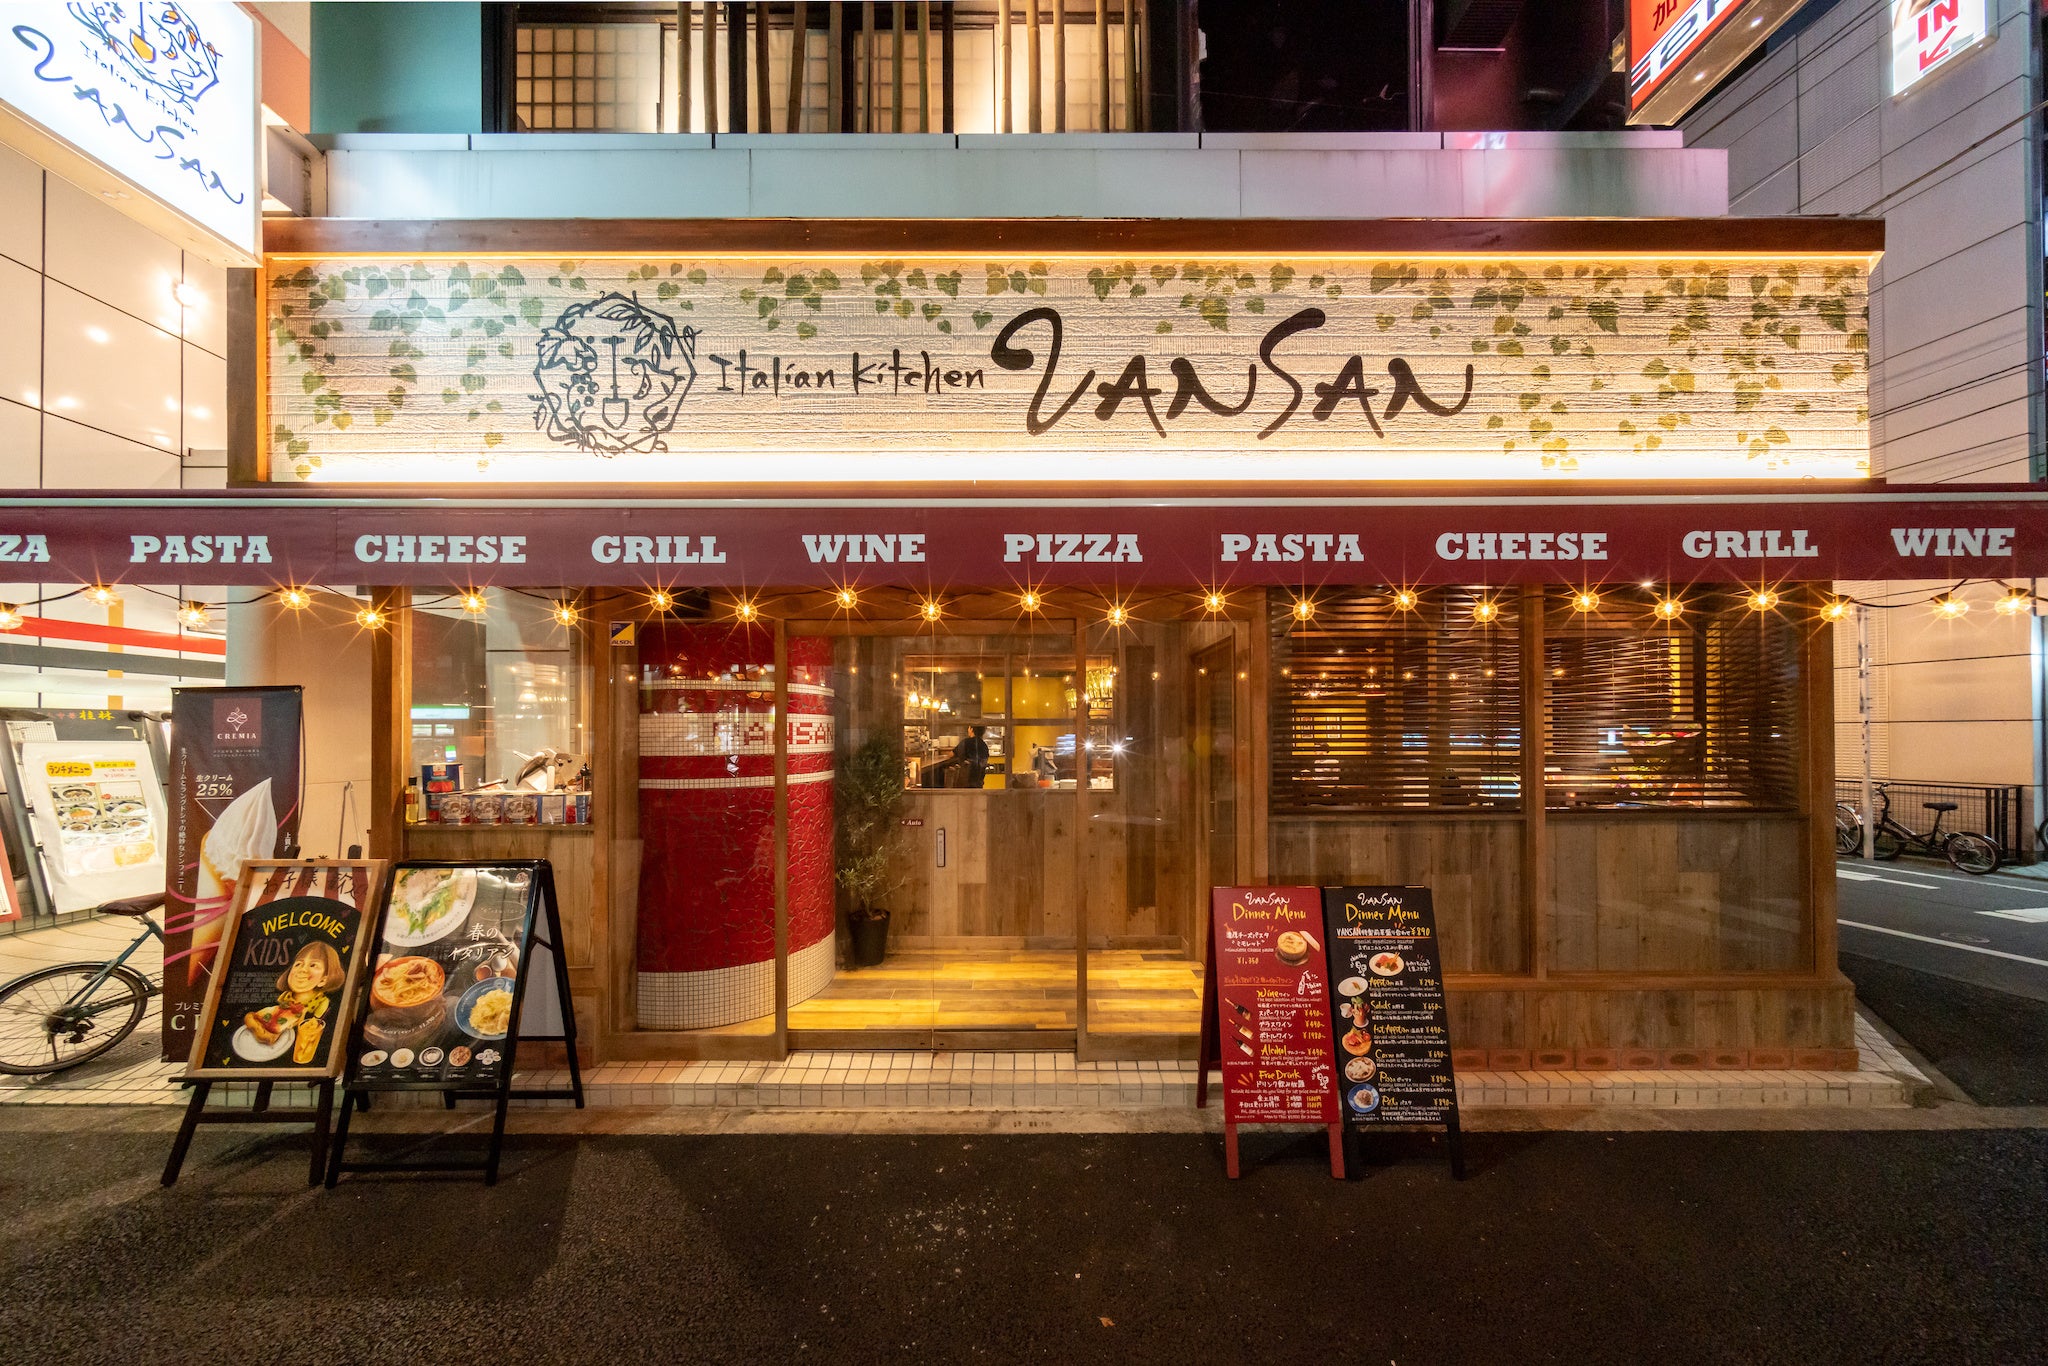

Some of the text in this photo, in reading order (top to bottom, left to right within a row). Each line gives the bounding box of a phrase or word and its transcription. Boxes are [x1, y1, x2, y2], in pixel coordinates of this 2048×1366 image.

[1918, 0, 1959, 44] IN
[708, 348, 835, 399] Italian
[129, 535, 273, 564] PASTA
[354, 534, 527, 564] CHEESE
[591, 535, 727, 564] GRILL
[801, 533, 926, 563] WINE
[1003, 533, 1143, 562] PIZZA
[1220, 534, 1365, 562] PASTA
[1435, 532, 1608, 561] CHEESE
[1682, 530, 1819, 559] GRILL
[1891, 528, 2015, 557] WINE
[48, 765, 91, 774] ランチメニュー
[195, 774, 234, 783] 生クリーム
[196, 783, 234, 797] 25%
[1232, 902, 1307, 923] Dinner Menu
[1345, 903, 1420, 924] Dinner Menu
[262, 910, 346, 939] WELCOME
[466, 922, 499, 942] 春の
[242, 938, 294, 967] KIDS
[447, 947, 515, 962] イタリアン
[1256, 987, 1279, 998] Wine
[175, 1002, 205, 1012] プレミ
[1259, 1009, 1296, 1017] スパークリング
[1260, 1043, 1287, 1056] Alcohol
[1259, 1069, 1301, 1080] Free Drink
